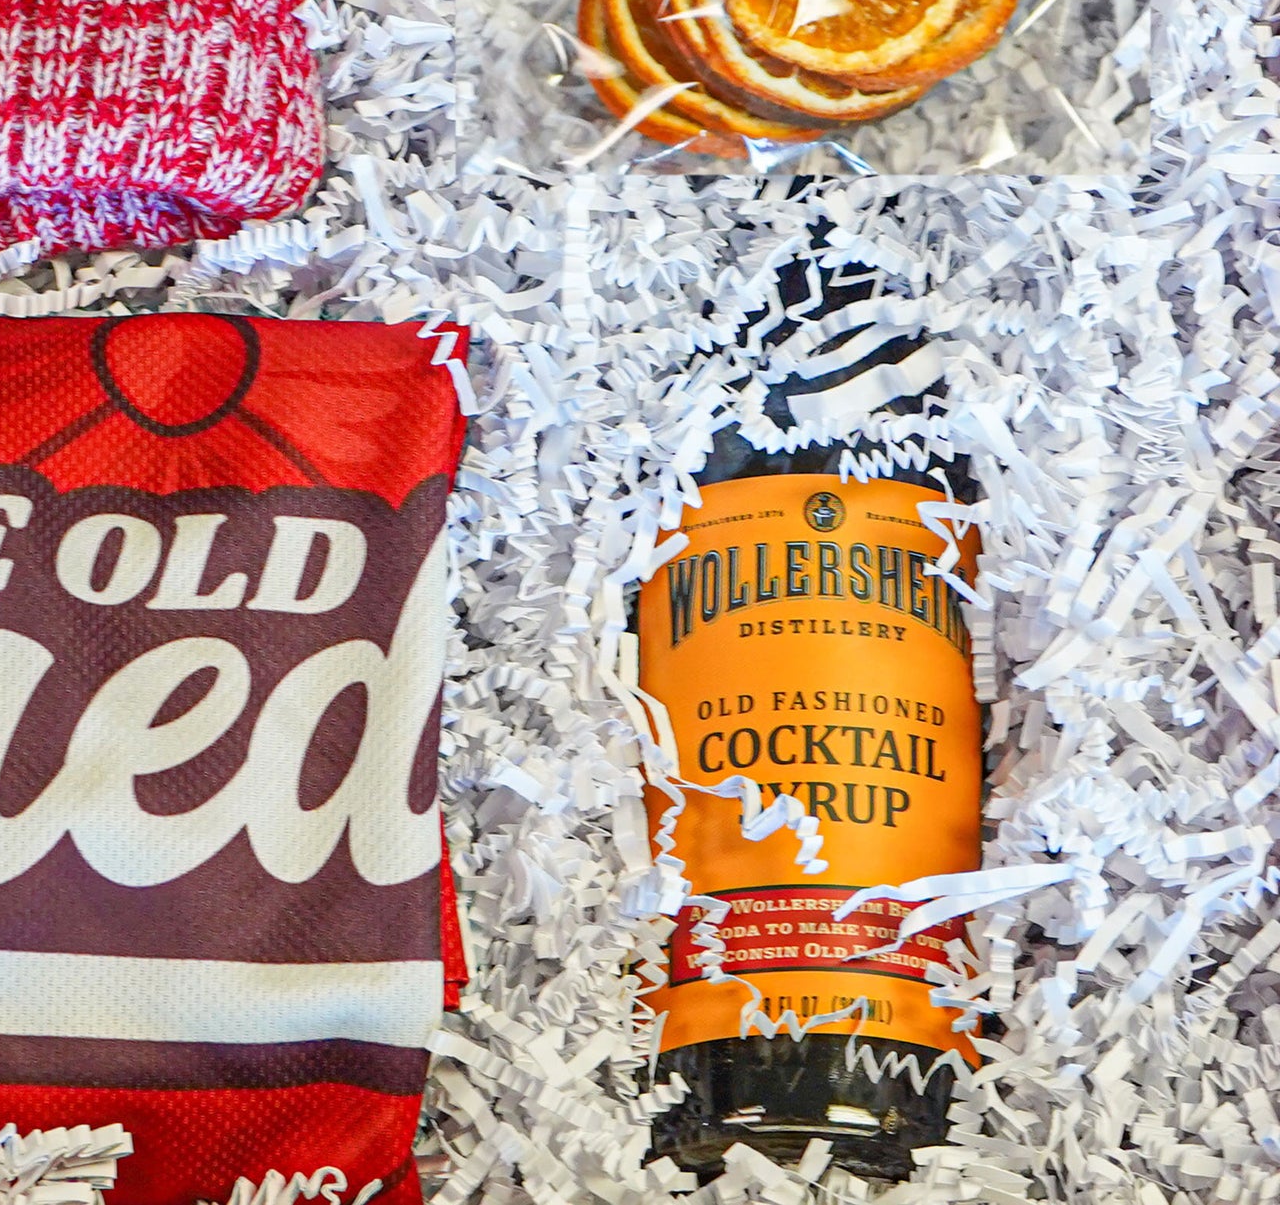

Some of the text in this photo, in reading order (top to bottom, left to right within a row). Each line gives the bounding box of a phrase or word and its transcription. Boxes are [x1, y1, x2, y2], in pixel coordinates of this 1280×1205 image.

[56, 512, 368, 614] OLD
[739, 619, 908, 642] DISTILLERY
[697, 691, 946, 727] OLD FASHIONED
[699, 724, 946, 782] COCKTAIL
[739, 781, 911, 828] YRUP
[714, 924, 761, 940] ODA
[764, 922, 793, 935] TO
[798, 922, 860, 936] MAKE
[863, 925, 912, 943] YOU
[804, 942, 848, 958] OLD
